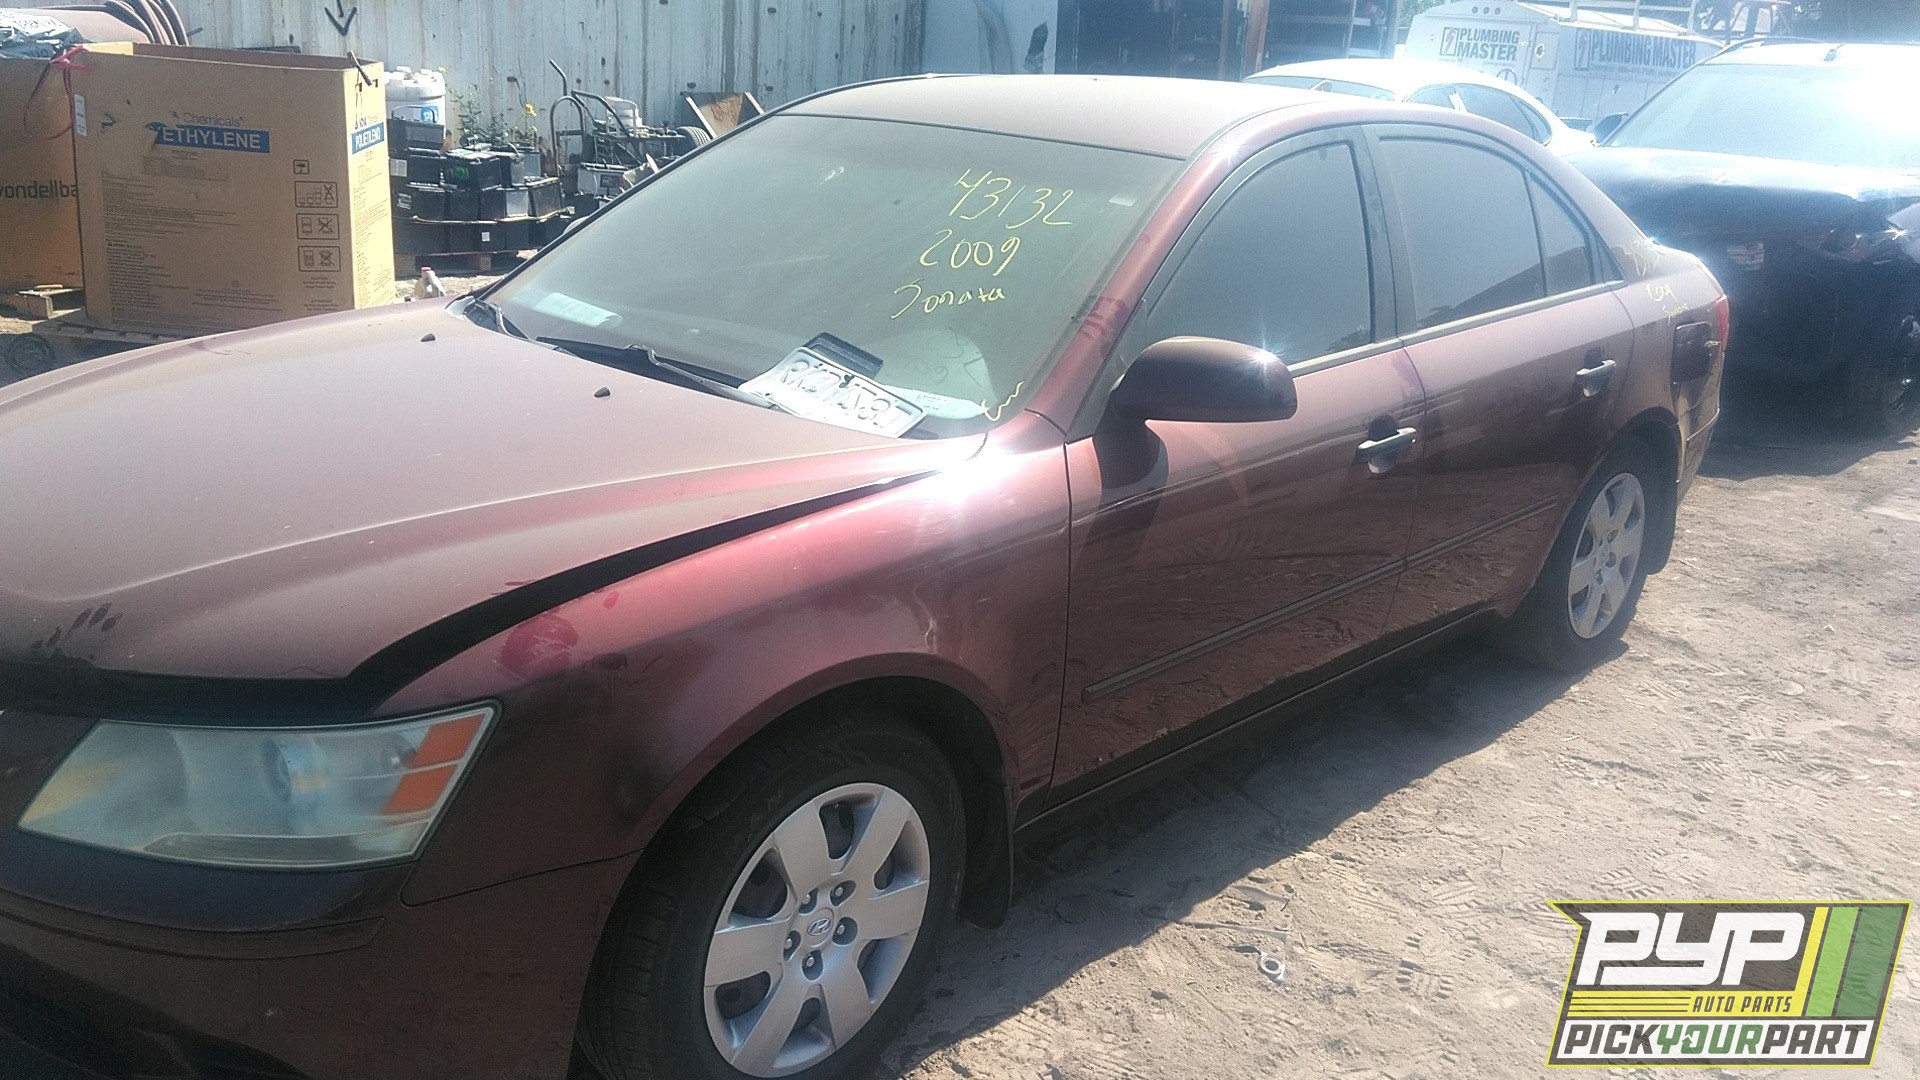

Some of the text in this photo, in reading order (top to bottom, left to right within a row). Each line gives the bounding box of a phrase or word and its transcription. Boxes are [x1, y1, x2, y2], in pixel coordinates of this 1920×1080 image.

[1456, 41, 1518, 61] MASTER
[1460, 28, 1520, 44] PLUMBING
[1589, 28, 1696, 69] PLUMBING MASTER
[949, 168, 1074, 229] 43132
[919, 229, 1020, 277] 2009
[890, 278, 1006, 319] Sonata
